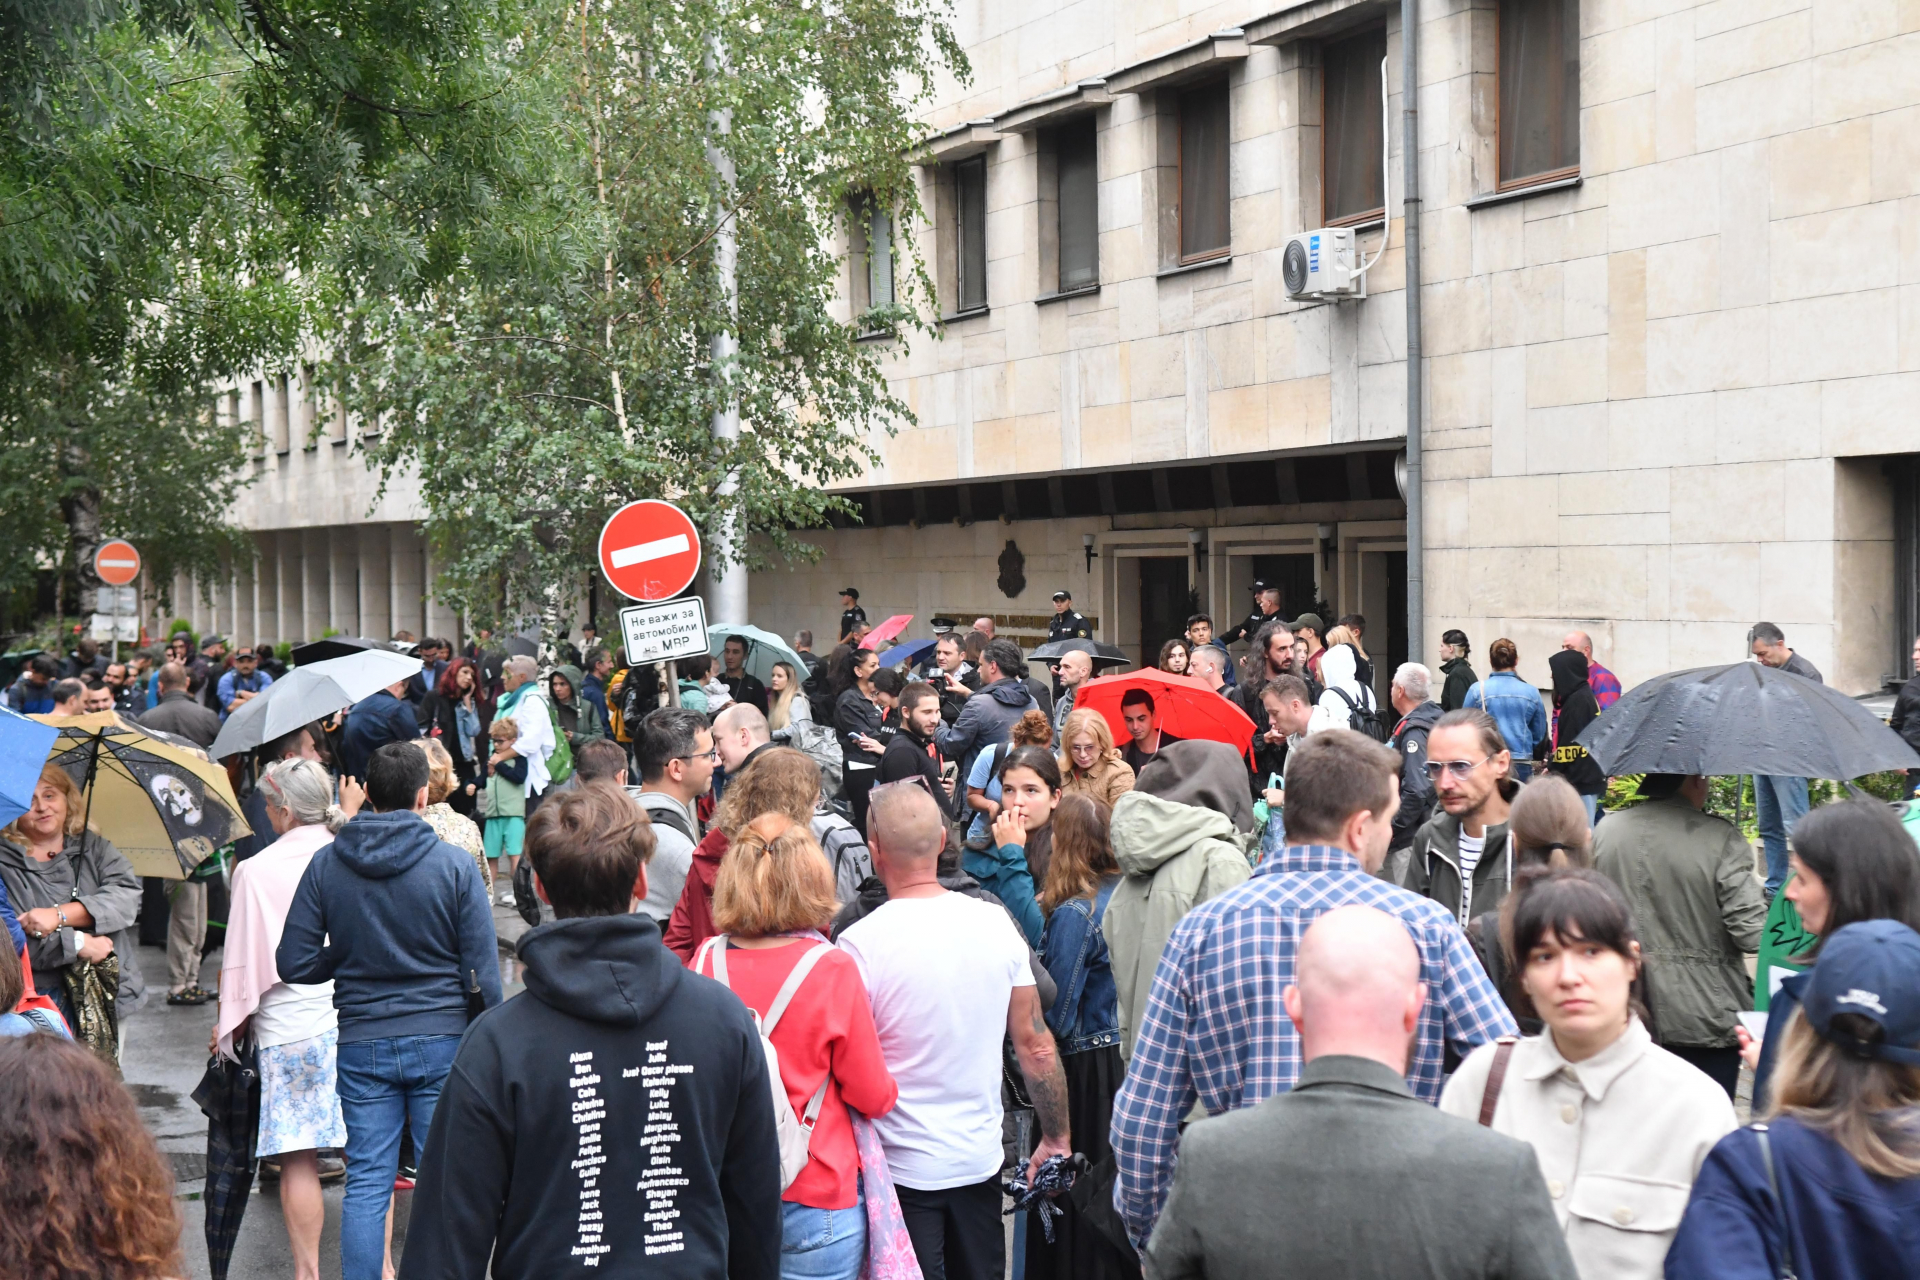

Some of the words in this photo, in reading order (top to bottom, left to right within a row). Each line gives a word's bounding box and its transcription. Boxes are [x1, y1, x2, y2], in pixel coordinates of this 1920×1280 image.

[631, 617, 646, 628] Не
[648, 612, 678, 624] важи
[682, 610, 694, 619] за
[633, 623, 698, 641] автомобили
[662, 636, 690, 651] МВР
[569, 1052, 593, 1063] Alexa
[648, 1052, 666, 1063] Julie
[575, 1064, 591, 1074] Ben
[622, 1067, 639, 1078] Just
[641, 1065, 664, 1076] Oscar
[665, 1064, 694, 1076] please
[649, 1088, 669, 1099] Kelly
[650, 1100, 669, 1109] Luke
[644, 1123, 678, 1134] Margaux
[640, 1133, 681, 1146] Margherita
[579, 1145, 601, 1156] Felipe
[580, 1189, 600, 1199] Irene
[646, 1189, 677, 1199] Shayan
[581, 1199, 599, 1210] Jack
[579, 1210, 602, 1221] Jacob
[578, 1222, 603, 1233] Jazzy
[653, 1222, 672, 1231] Theo
[644, 1232, 683, 1244] Tommaso
[571, 1244, 610, 1255] Jonathan
